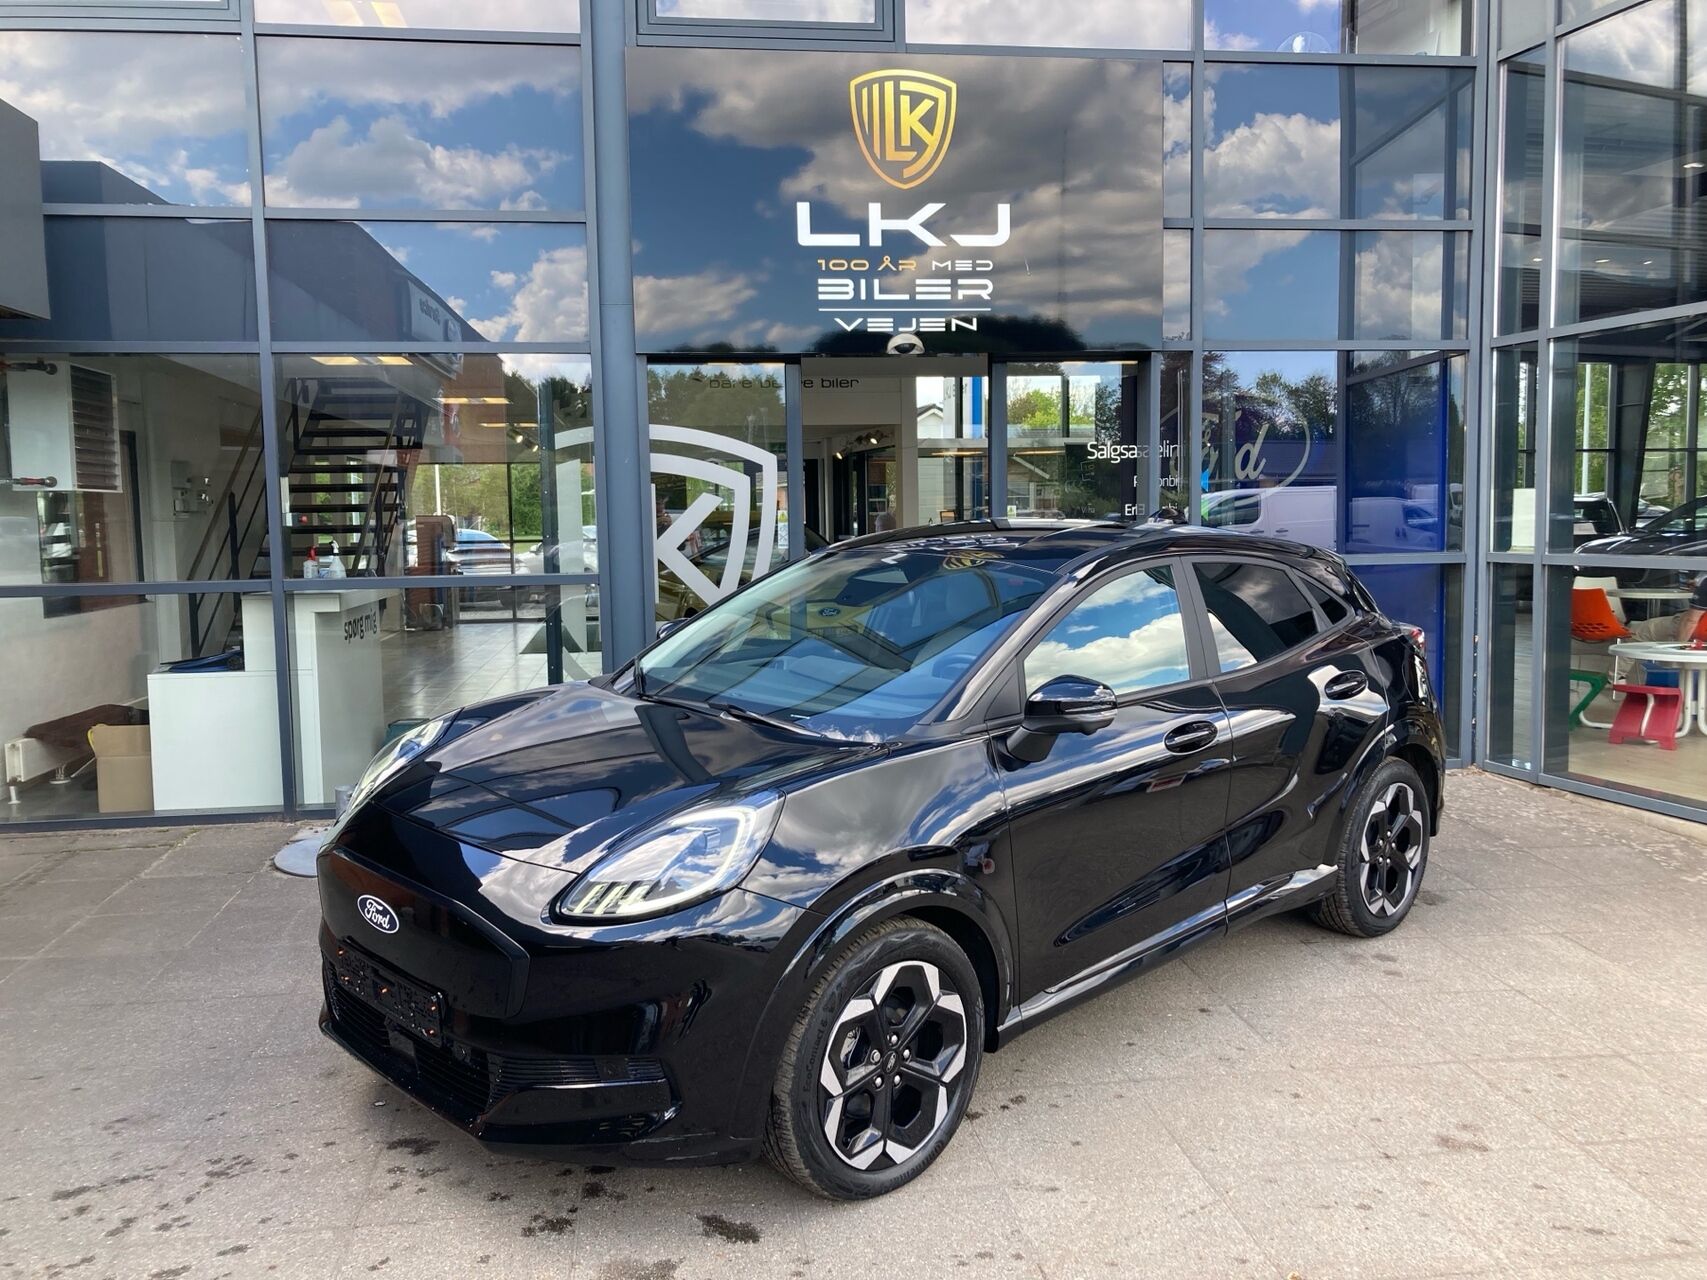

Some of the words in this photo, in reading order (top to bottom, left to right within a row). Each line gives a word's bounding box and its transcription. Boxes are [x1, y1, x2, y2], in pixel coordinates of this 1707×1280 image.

[796, 201, 1011, 248] LKJ
[817, 259, 870, 271] 100
[877, 255, 917, 271] ÅR
[931, 259, 994, 271] MED
[817, 278, 994, 300] BILER
[833, 317, 978, 332] VEJEN
[821, 378, 860, 389] biler
